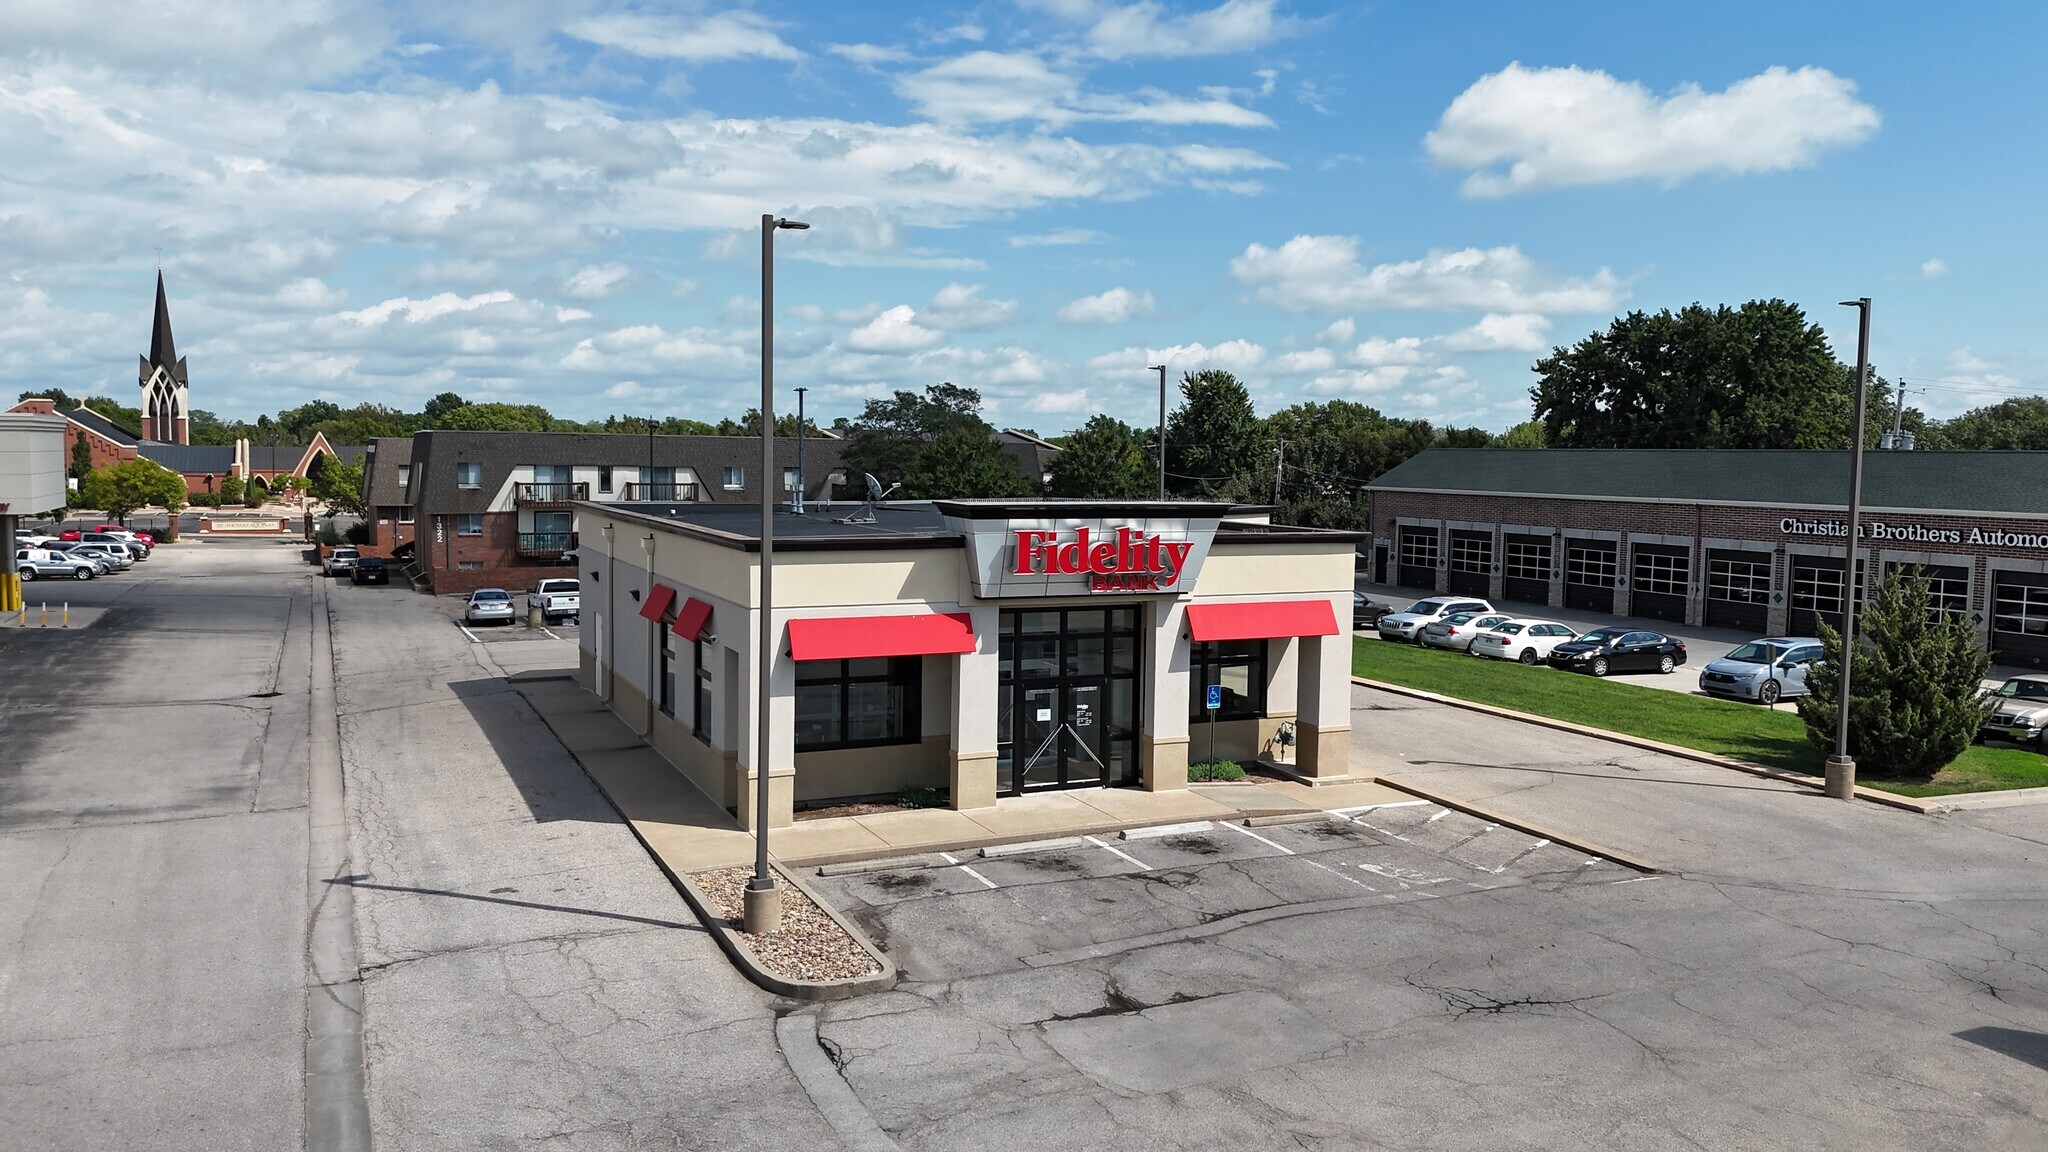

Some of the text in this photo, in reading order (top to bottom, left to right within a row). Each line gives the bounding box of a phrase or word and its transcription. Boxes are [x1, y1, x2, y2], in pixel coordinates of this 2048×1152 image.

[1780, 518, 2048, 549] Christian Brothers Automo
[1013, 526, 1194, 587] Fidelity
[1091, 574, 1160, 592] BANK
